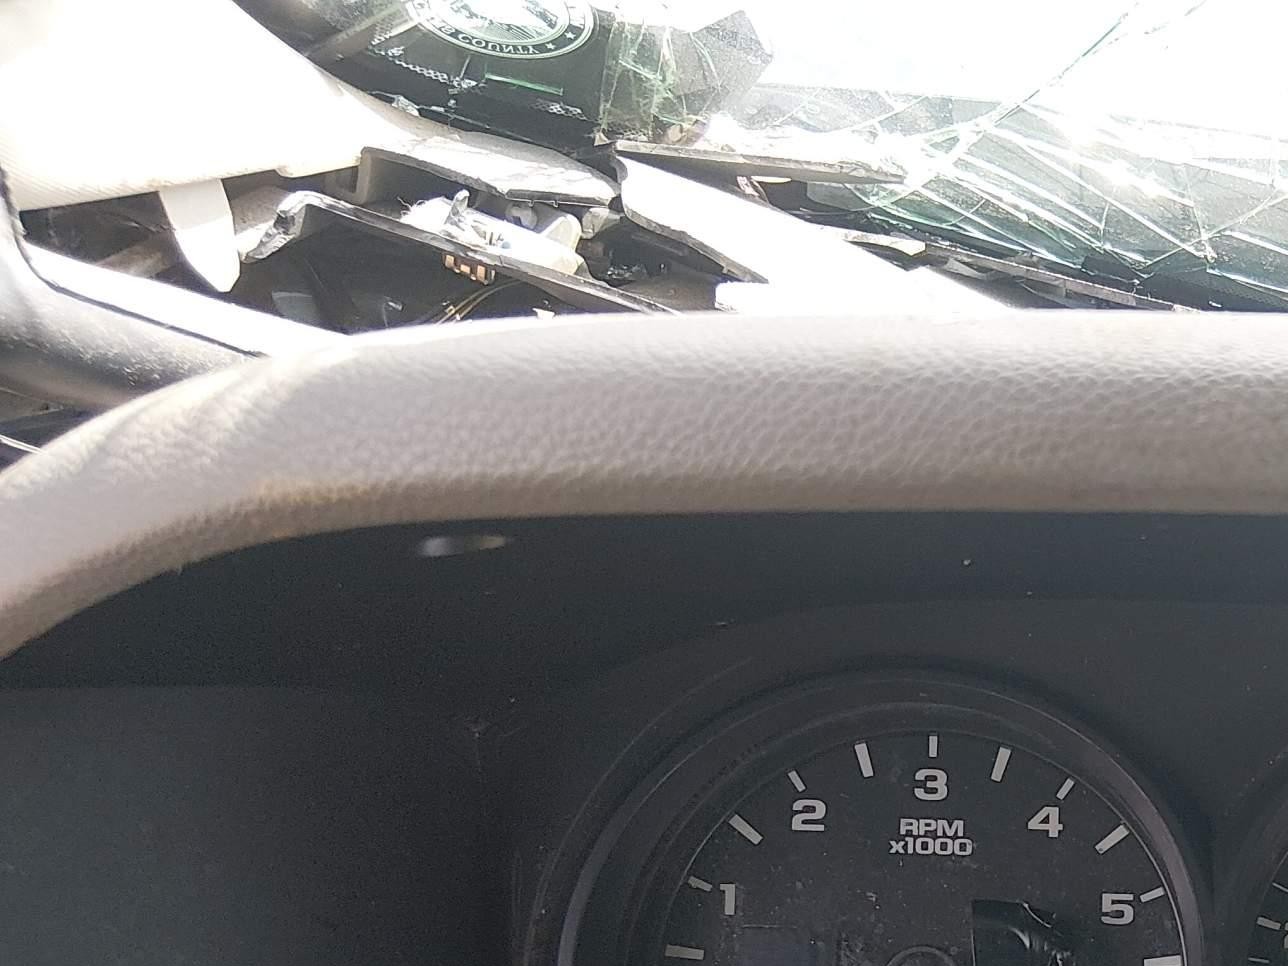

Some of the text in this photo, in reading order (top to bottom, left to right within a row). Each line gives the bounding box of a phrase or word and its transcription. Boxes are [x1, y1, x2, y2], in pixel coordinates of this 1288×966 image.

[914, 769, 948, 800] 3
[791, 800, 826, 832] 2
[899, 818, 964, 837] RPM
[1027, 806, 1063, 837] 4
[888, 837, 973, 856] x1000
[720, 883, 736, 915] 1
[1101, 893, 1134, 925] 5
